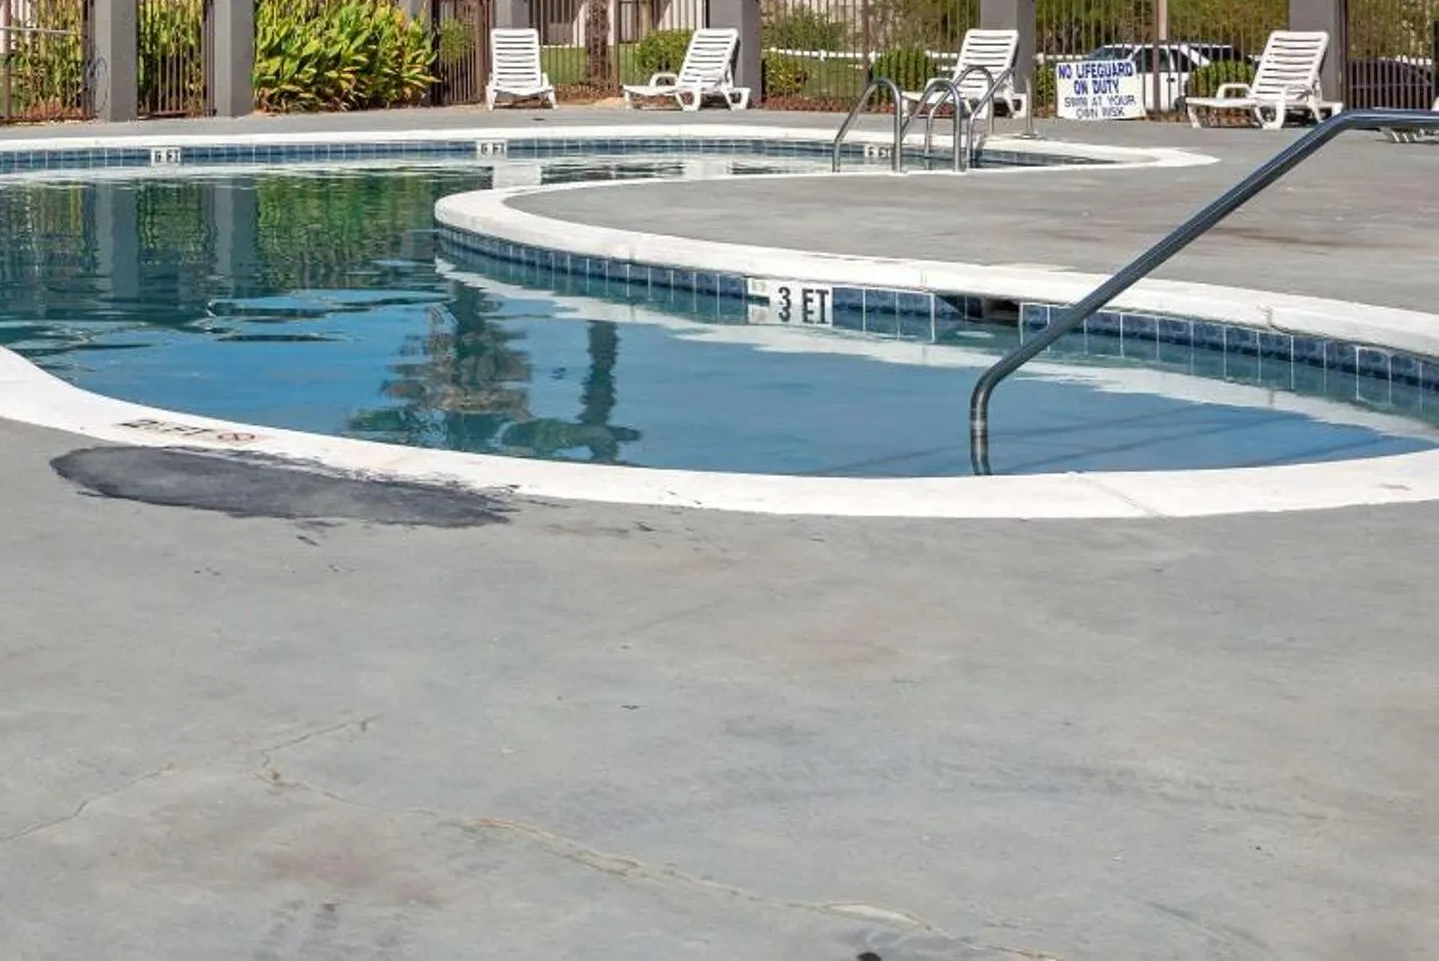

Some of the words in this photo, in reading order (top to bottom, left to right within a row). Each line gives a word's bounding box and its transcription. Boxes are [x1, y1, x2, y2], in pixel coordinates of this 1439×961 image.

[1058, 64, 1072, 79] NO
[1076, 62, 1134, 79] LIFEGUARD
[1074, 80, 1089, 95] ON
[1092, 79, 1120, 94] DUTY
[1106, 95, 1137, 106] YOUR
[778, 286, 792, 323] 3
